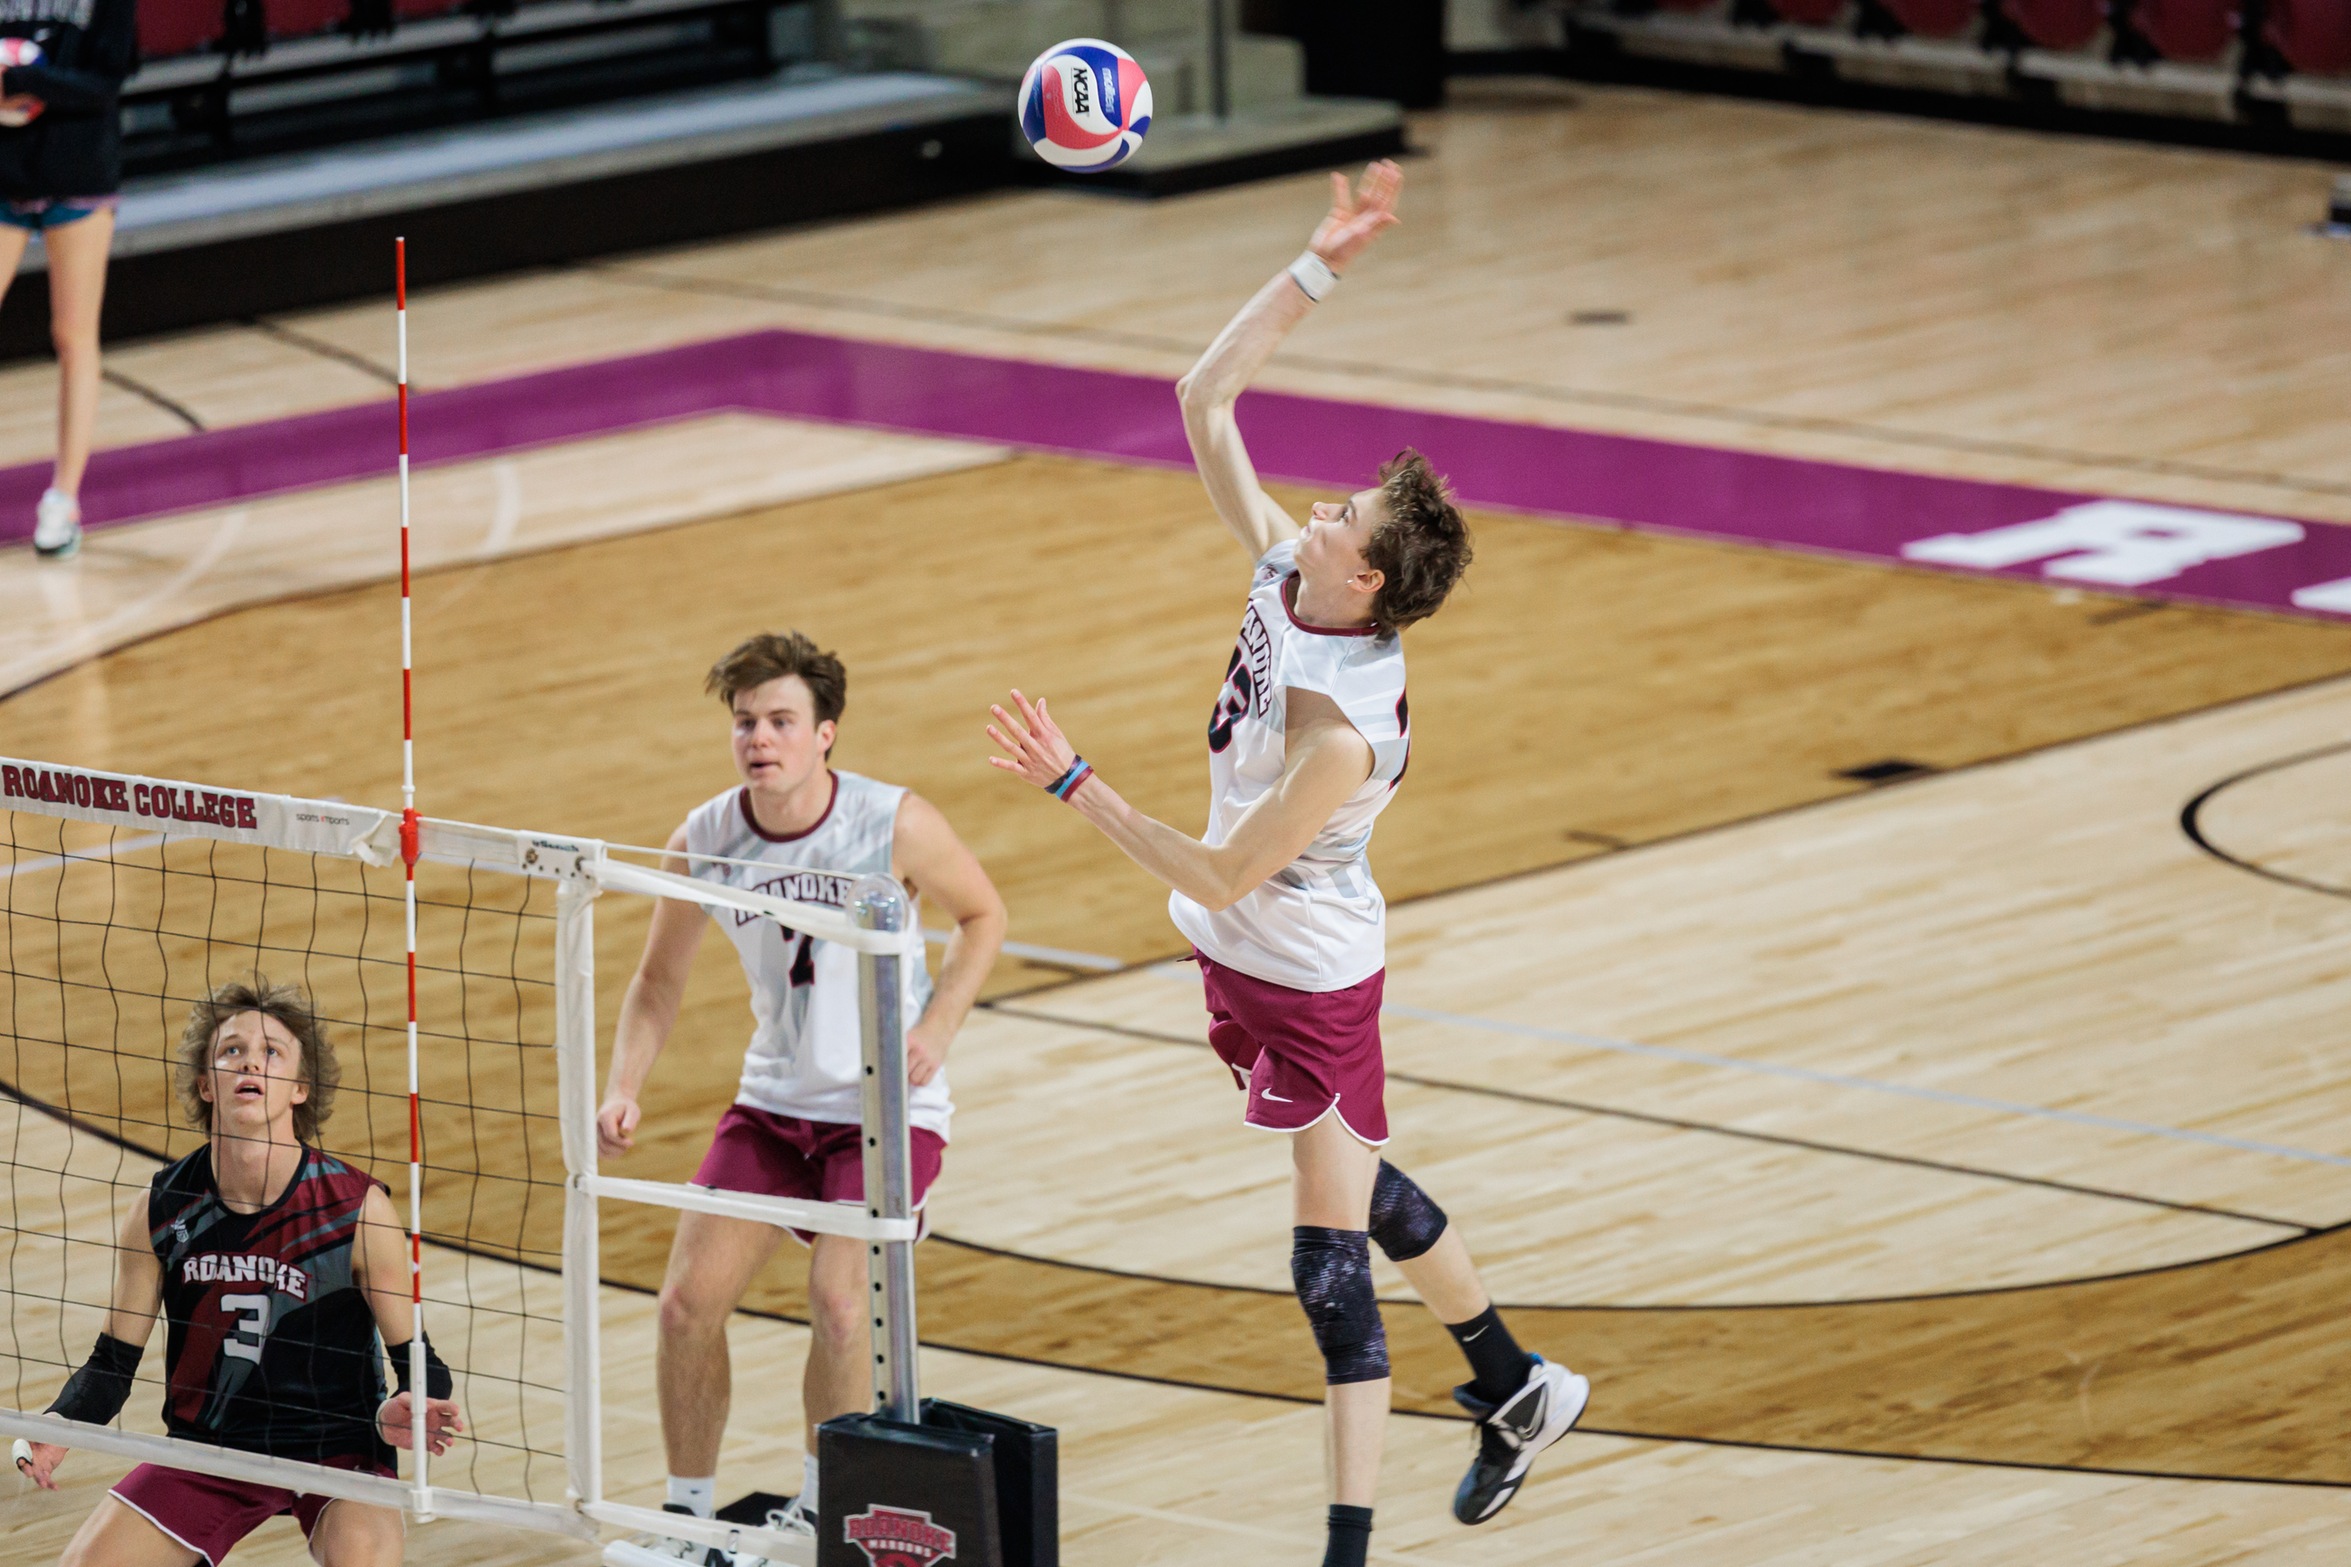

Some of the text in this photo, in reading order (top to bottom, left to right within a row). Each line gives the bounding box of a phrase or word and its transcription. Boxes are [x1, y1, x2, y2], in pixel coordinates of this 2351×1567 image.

[1073, 67, 1090, 114] NCAA
[1, 765, 258, 830] ROANOKE COLLEGE
[183, 1254, 309, 1301] ROANOKE
[219, 1292, 272, 1366] 3
